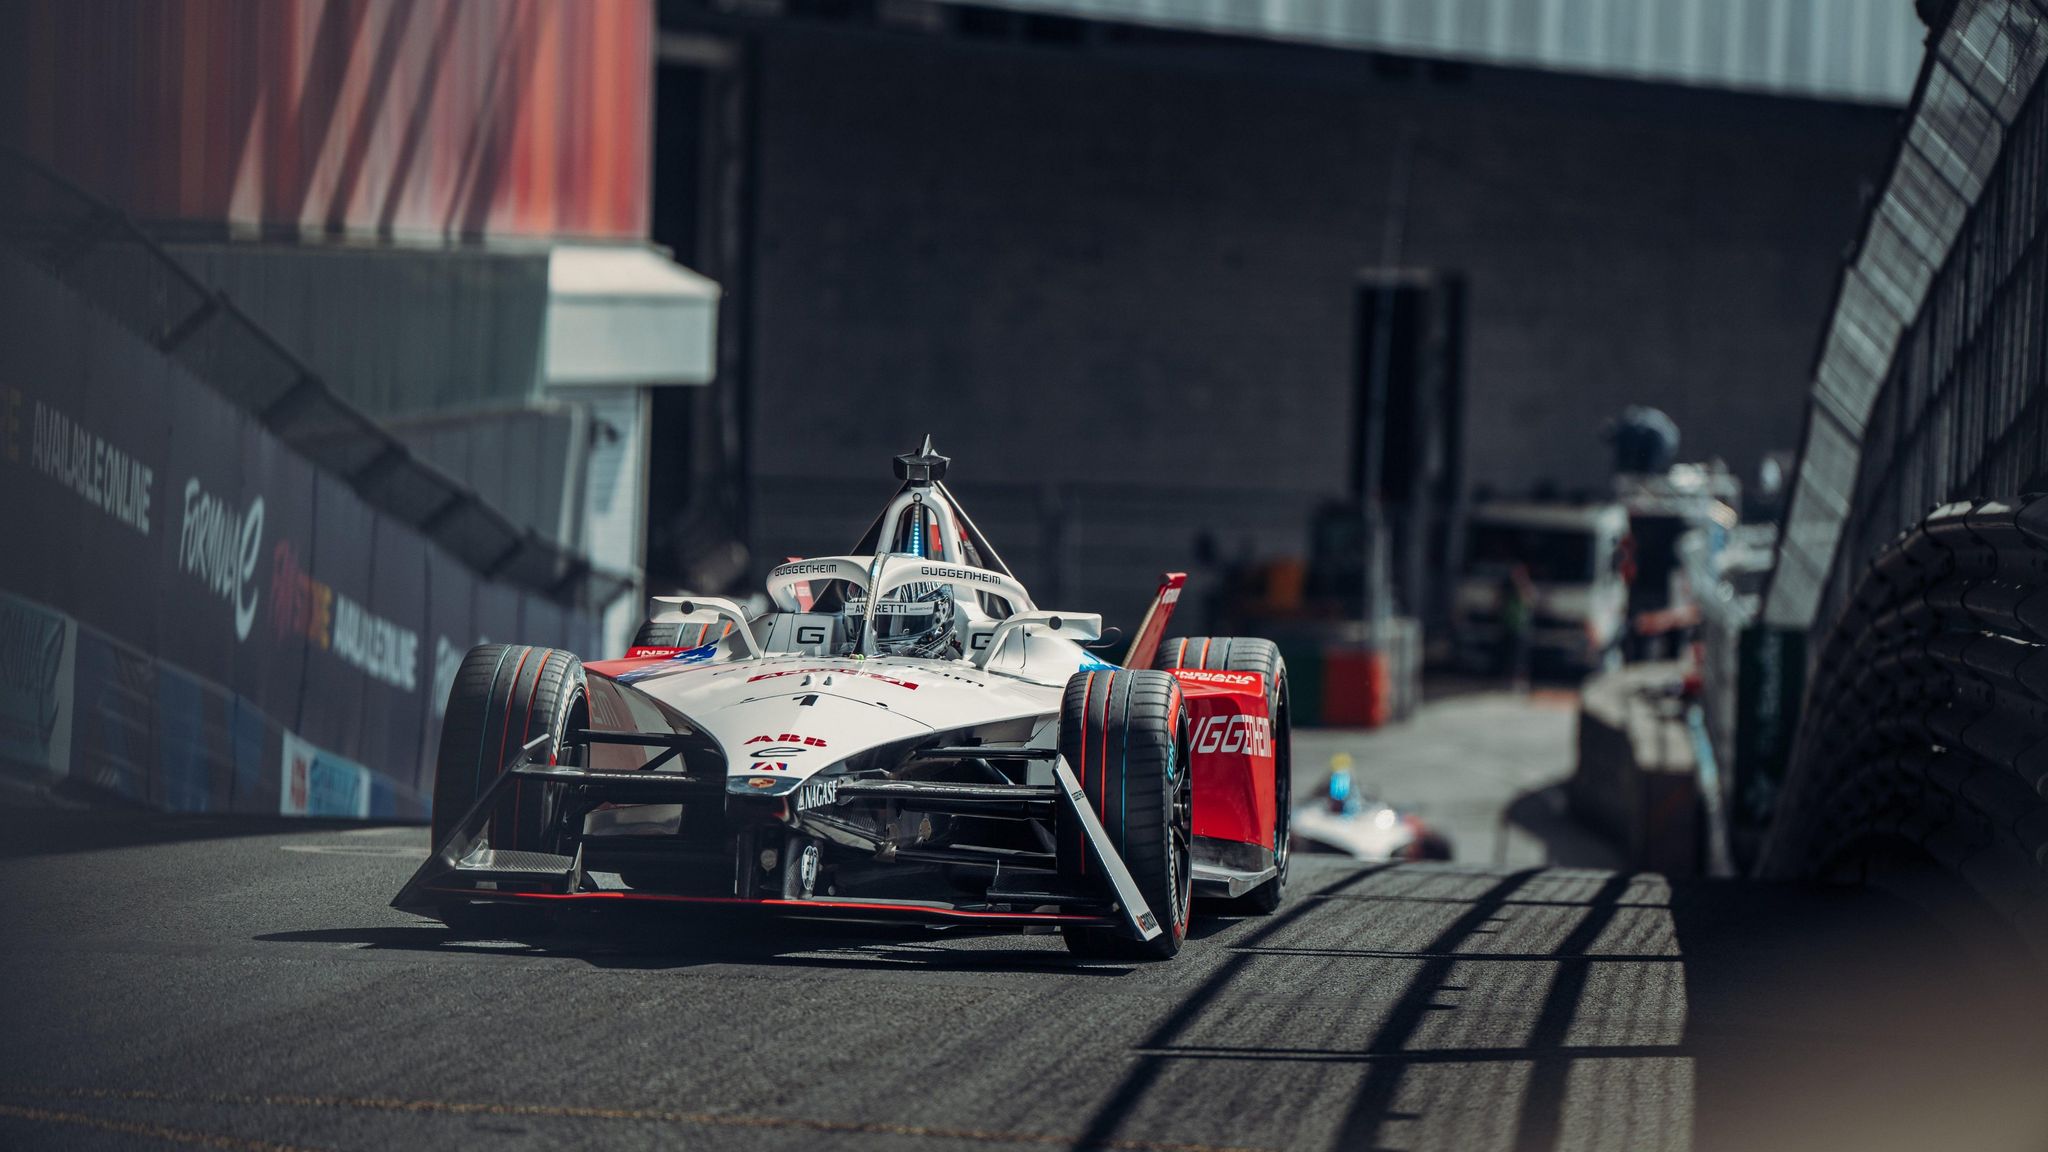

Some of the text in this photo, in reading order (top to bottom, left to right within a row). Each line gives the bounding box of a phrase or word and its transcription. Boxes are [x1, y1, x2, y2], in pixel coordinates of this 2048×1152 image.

[774, 564, 837, 577] GUGGENHEIM
[920, 566, 1001, 585] GUGGENHEIM
[855, 604, 907, 614] ANRETTI
[743, 733, 828, 748] ABB
[1188, 714, 1272, 758] UGGENHEIM
[805, 780, 838, 810] NAGASE
